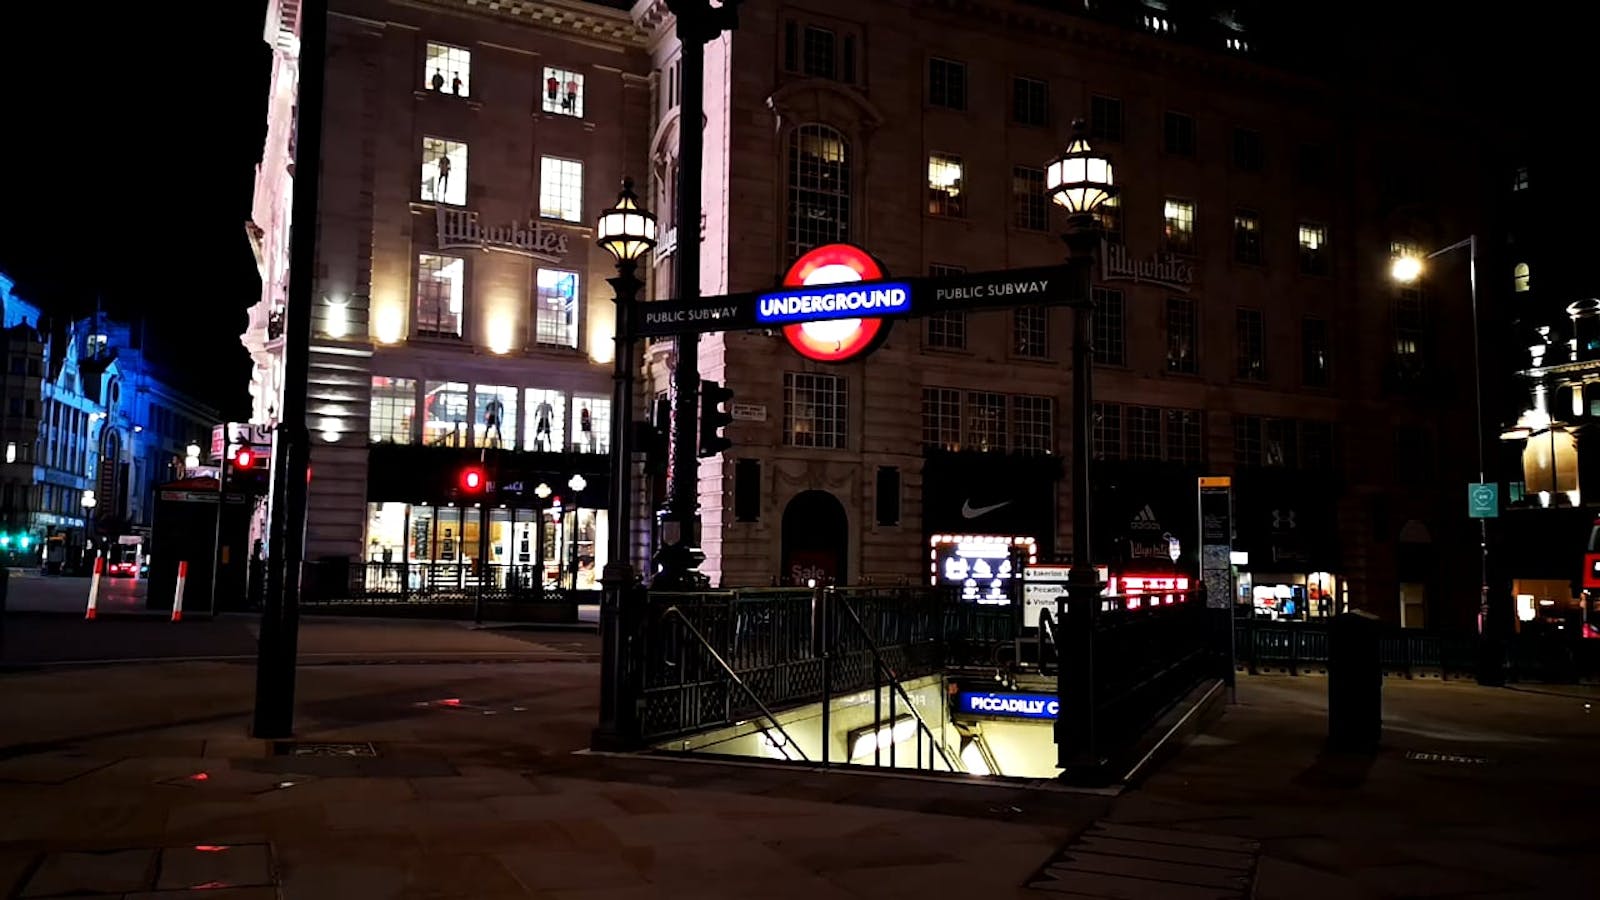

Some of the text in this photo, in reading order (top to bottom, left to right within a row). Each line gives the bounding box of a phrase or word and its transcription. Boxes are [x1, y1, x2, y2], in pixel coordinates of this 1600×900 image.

[436, 203, 569, 260] Lillywhites
[1100, 238, 1194, 290] Lillywhites
[936, 280, 1049, 300] PUBLIC SUBWAY
[760, 289, 906, 316] UNDERGROUND
[646, 306, 738, 323] PUBLIC SUBWAY
[791, 564, 825, 579] Sale
[970, 697, 1045, 714] PICCADILLY
